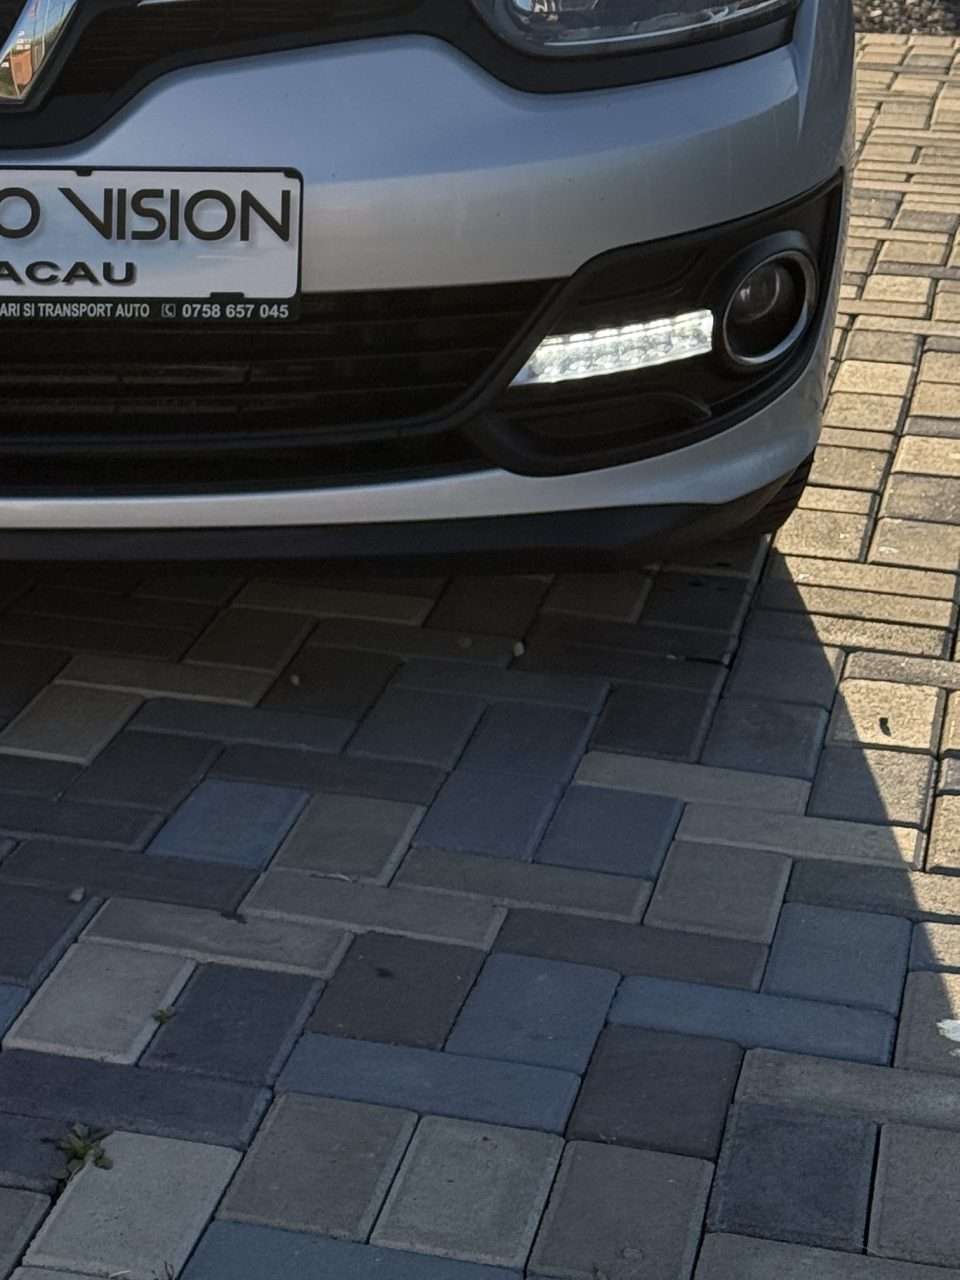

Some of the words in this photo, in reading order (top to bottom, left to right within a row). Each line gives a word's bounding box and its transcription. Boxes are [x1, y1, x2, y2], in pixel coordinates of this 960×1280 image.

[57, 186, 291, 242] VISION
[23, 302, 35, 317] SI
[38, 302, 114, 317] TRANSPORT
[116, 302, 150, 318] AUTO
[181, 303, 221, 318] 0758
[225, 303, 254, 318] 657
[259, 303, 289, 318] 045
